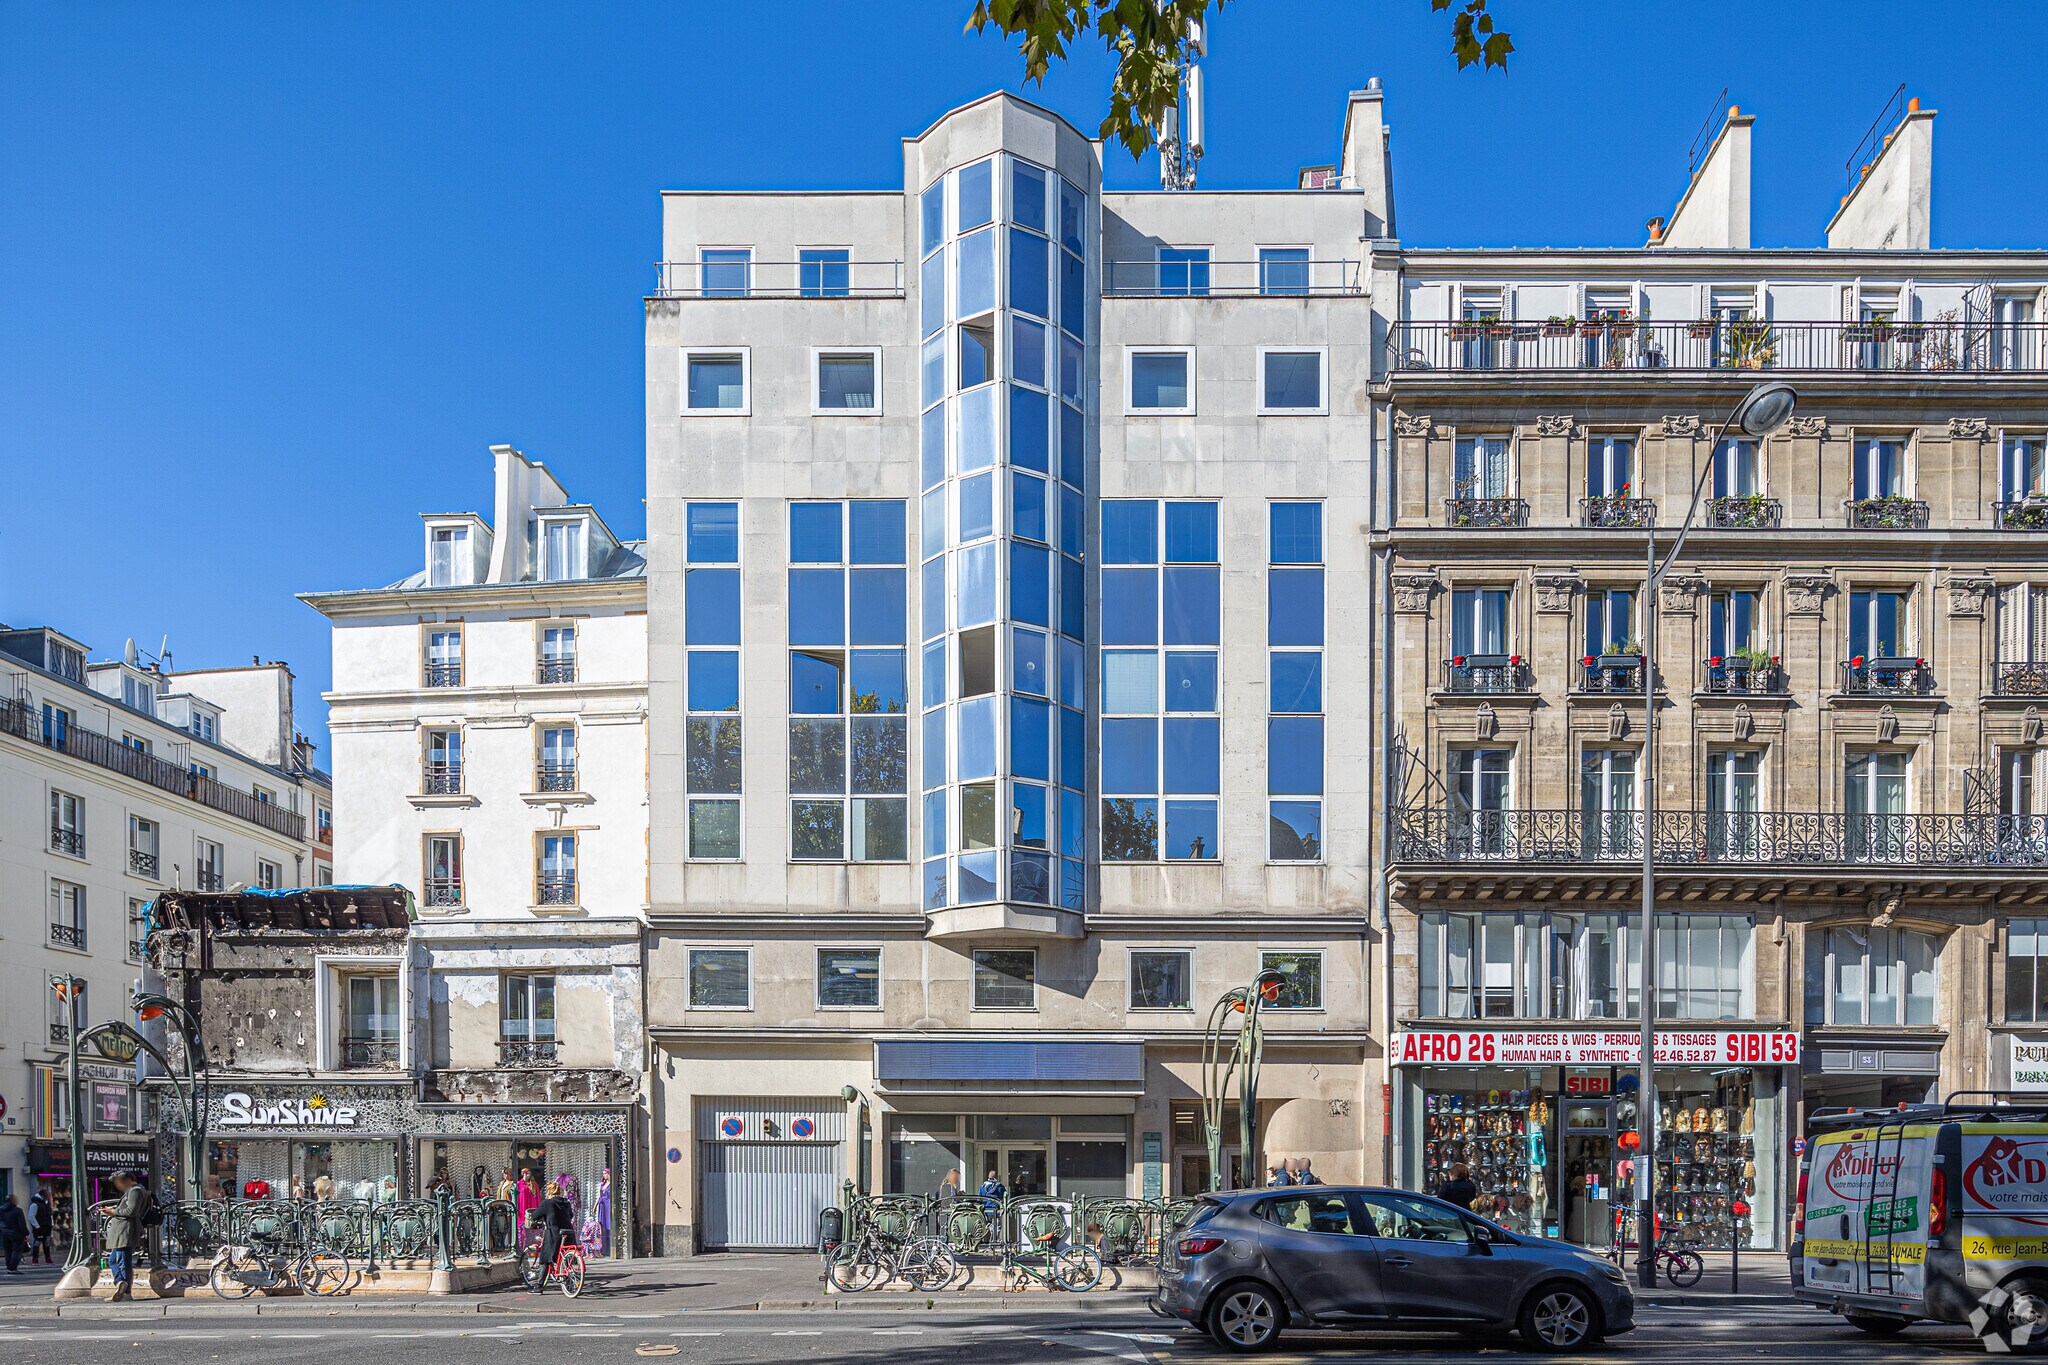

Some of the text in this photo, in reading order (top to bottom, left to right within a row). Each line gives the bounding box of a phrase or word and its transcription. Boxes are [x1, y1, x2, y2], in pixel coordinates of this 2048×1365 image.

[102, 1034, 134, 1055] METRO
[1403, 1033, 1495, 1061] AFRO 26
[1502, 1034, 1523, 1046] HAIR
[1527, 1034, 1558, 1046] PIECES
[1561, 1034, 1568, 1046] &
[1572, 1034, 1597, 1046] WIGS
[1604, 1034, 1659, 1046] PERRUQS
[1662, 1034, 1669, 1046] &
[1672, 1034, 1717, 1046] TISSAGES
[1726, 1033, 1797, 1062] SIBI 53
[1502, 1050, 1536, 1062] HUMAN
[1540, 1050, 1561, 1062] HAIR
[1565, 1050, 1571, 1062] &
[1579, 1050, 1630, 1062] SYNTHETIC
[96, 1085, 127, 1096] FASHION HAIR
[1567, 1077, 1609, 1093] SIBI
[86, 1151, 134, 1162] FASHION
[1989, 1192, 2018, 1203] votre
[1847, 1244, 1866, 1257] Charco
[1891, 1246, 1922, 1260] AUMALE
[1972, 1240, 1988, 1256] 26,
[1992, 1244, 2011, 1254] rue
